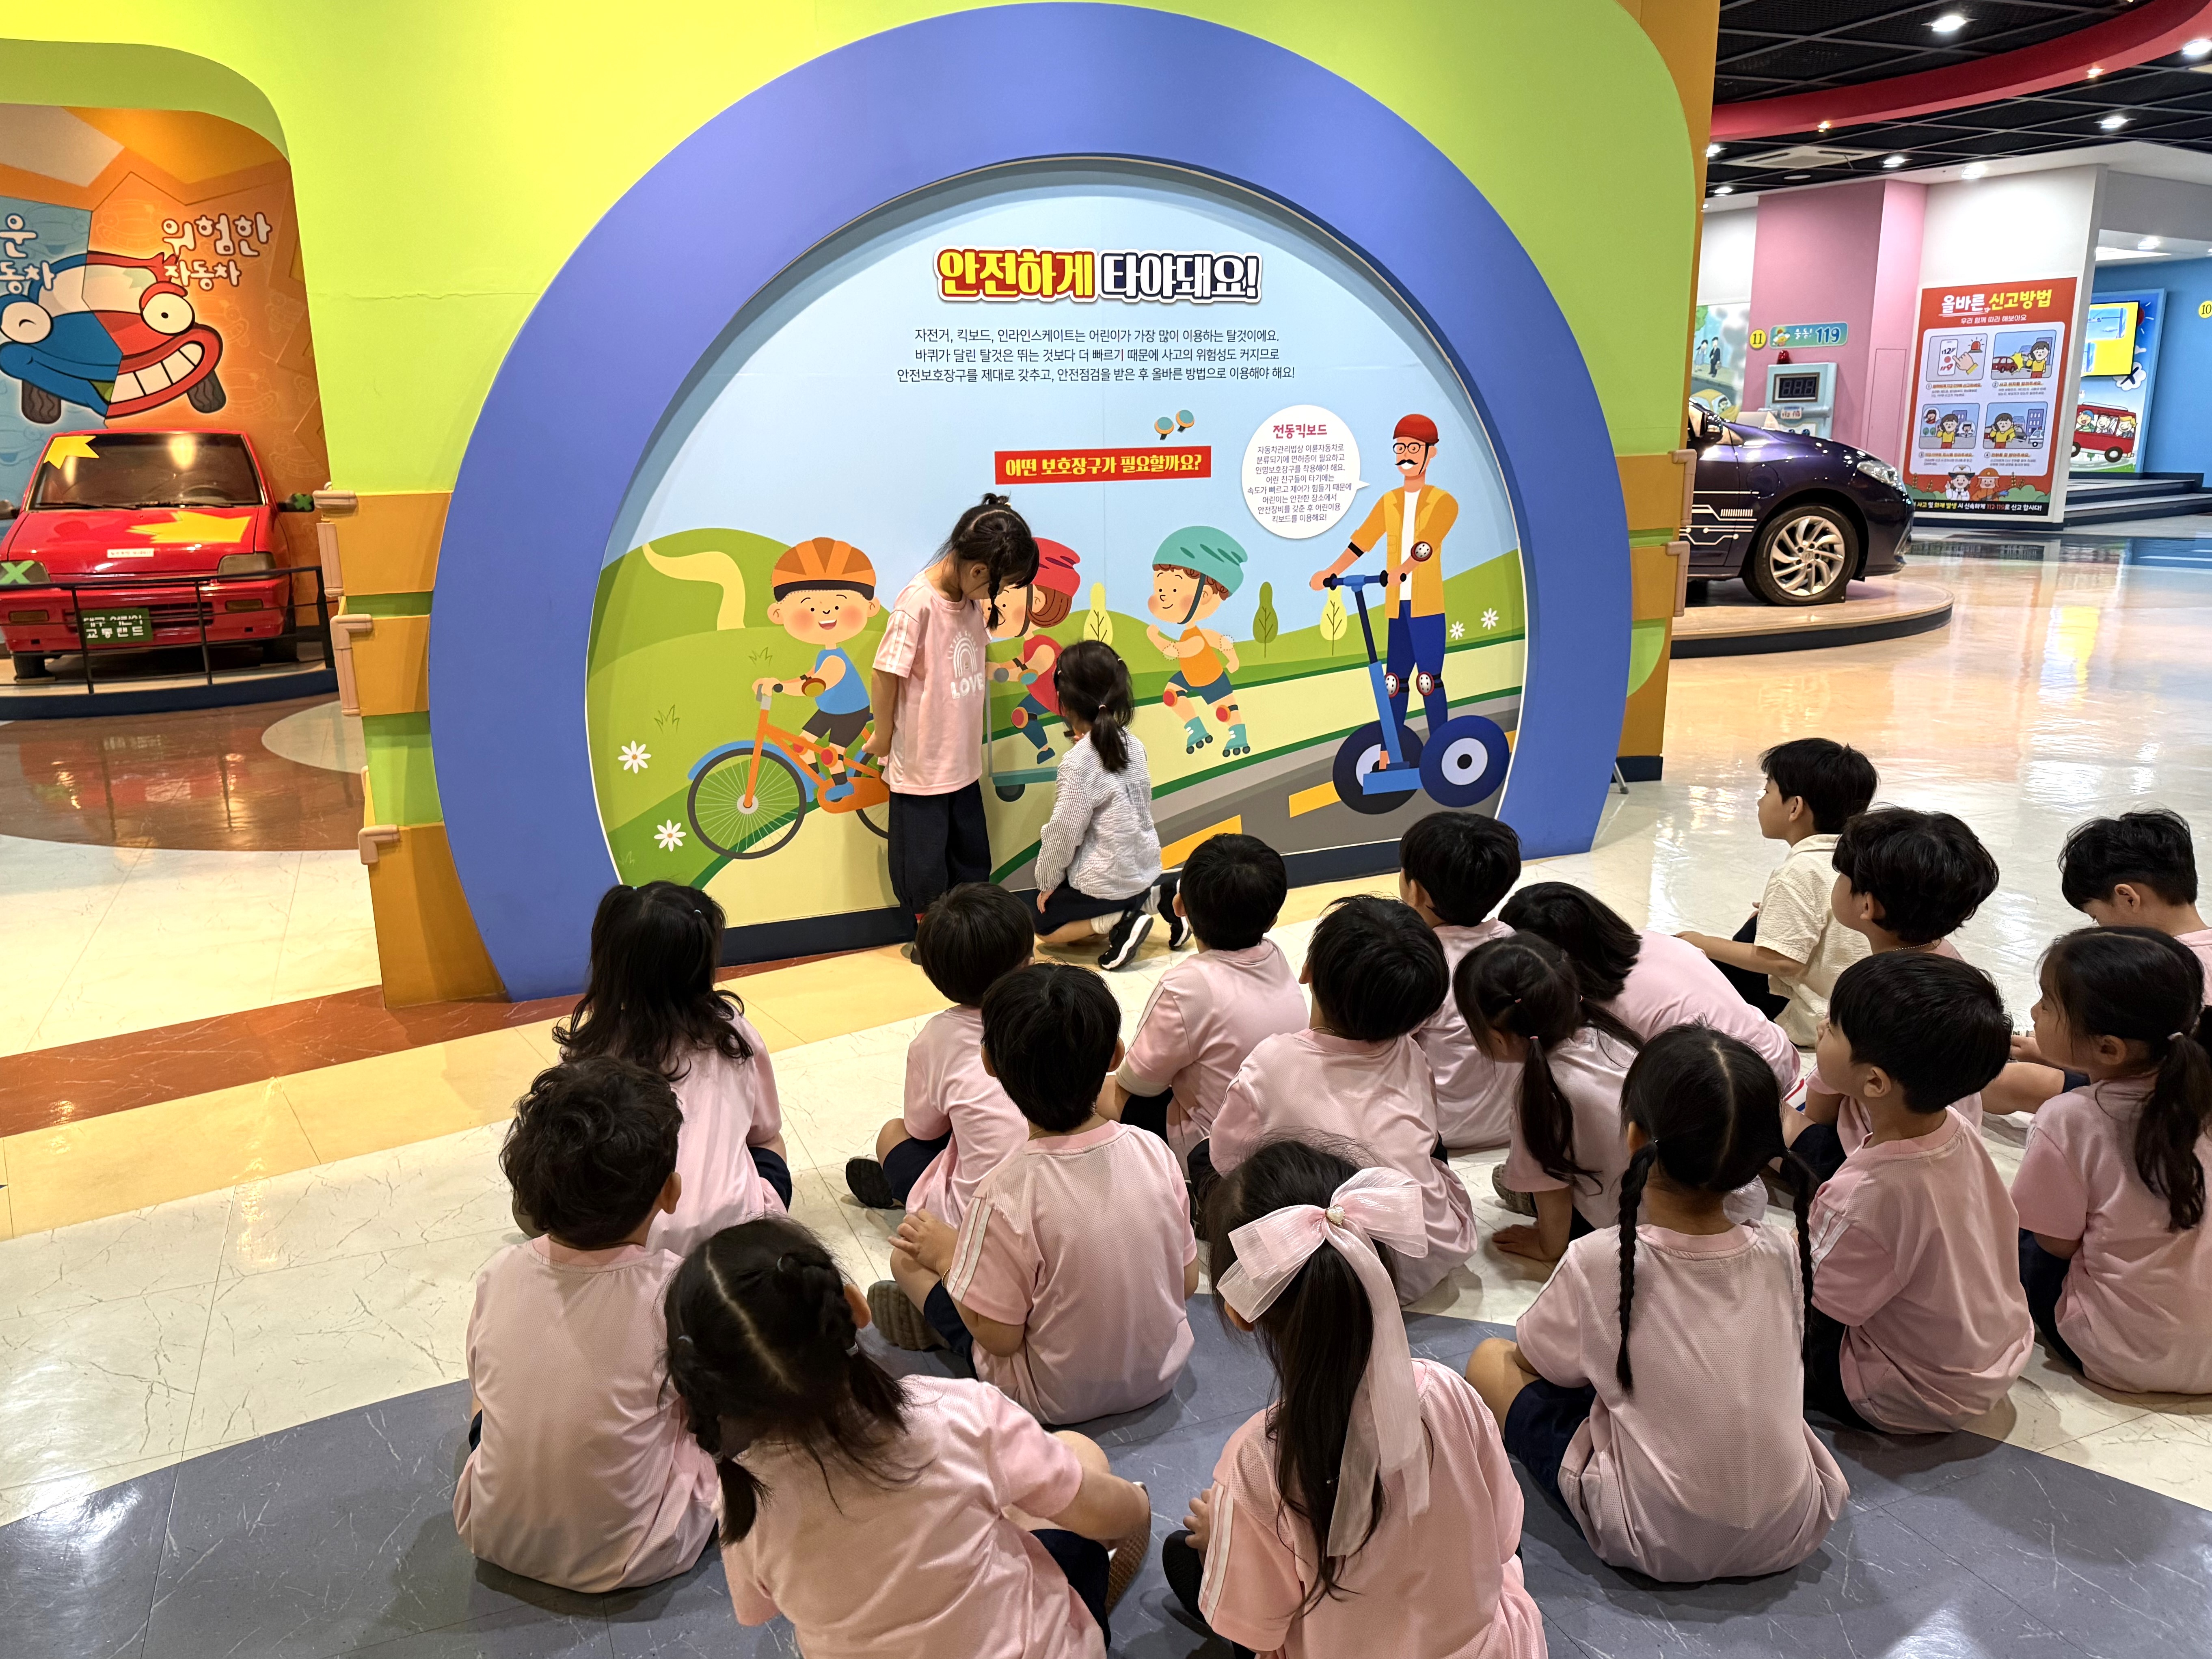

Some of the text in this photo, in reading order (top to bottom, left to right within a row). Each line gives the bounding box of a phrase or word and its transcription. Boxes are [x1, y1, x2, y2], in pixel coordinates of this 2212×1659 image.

[162, 212, 272, 256] 위험한
[163, 260, 241, 291] 자동차
[938, 250, 1258, 298] 안전하게 타야돼요!
[1941, 289, 2052, 314] 올바른 신고방법
[2201, 304, 2212, 315] 10
[915, 329, 1279, 343] 자전거, 킥보드, 인라인스케이트는 어린이가 가장 많이 이용하는 탈것이에요.
[1752, 333, 1763, 345] 11
[1816, 327, 1840, 343] 119
[915, 348, 1279, 363] 바퀴가 달린 탈것은 뛰는 것보다 더 빠르기 때문에 사고의 위험성도 커지므로
[896, 366, 1295, 383] 안전보호장구를 제대로 갖추고, 안전점검을 받은 후 올바른 방법으로 이용해야 해요!
[1272, 423, 1328, 439] 전동킥보드
[1257, 443, 1344, 454] 자동차관리법상 이륜자동차로
[1005, 454, 1202, 477] 어떤 보호장구가 필요할까요?
[1257, 454, 1345, 464] 분류되기에 면허증이 필요하고
[1255, 463, 1346, 475] 인명보호장구를 착용해야 해요.
[1266, 474, 1335, 484] 어린 친구들이 타기에는
[1247, 482, 1352, 495] 속도가 빠르고 제어가 힘들기 때문에
[1262, 493, 1337, 504] 어린이는 안전한 장소에서
[1257, 503, 1341, 514] 안전장비를 갖춘 후 어린이용
[1272, 513, 1327, 523] 킥보드를 이용해요!
[950, 672, 985, 699] LOVE
